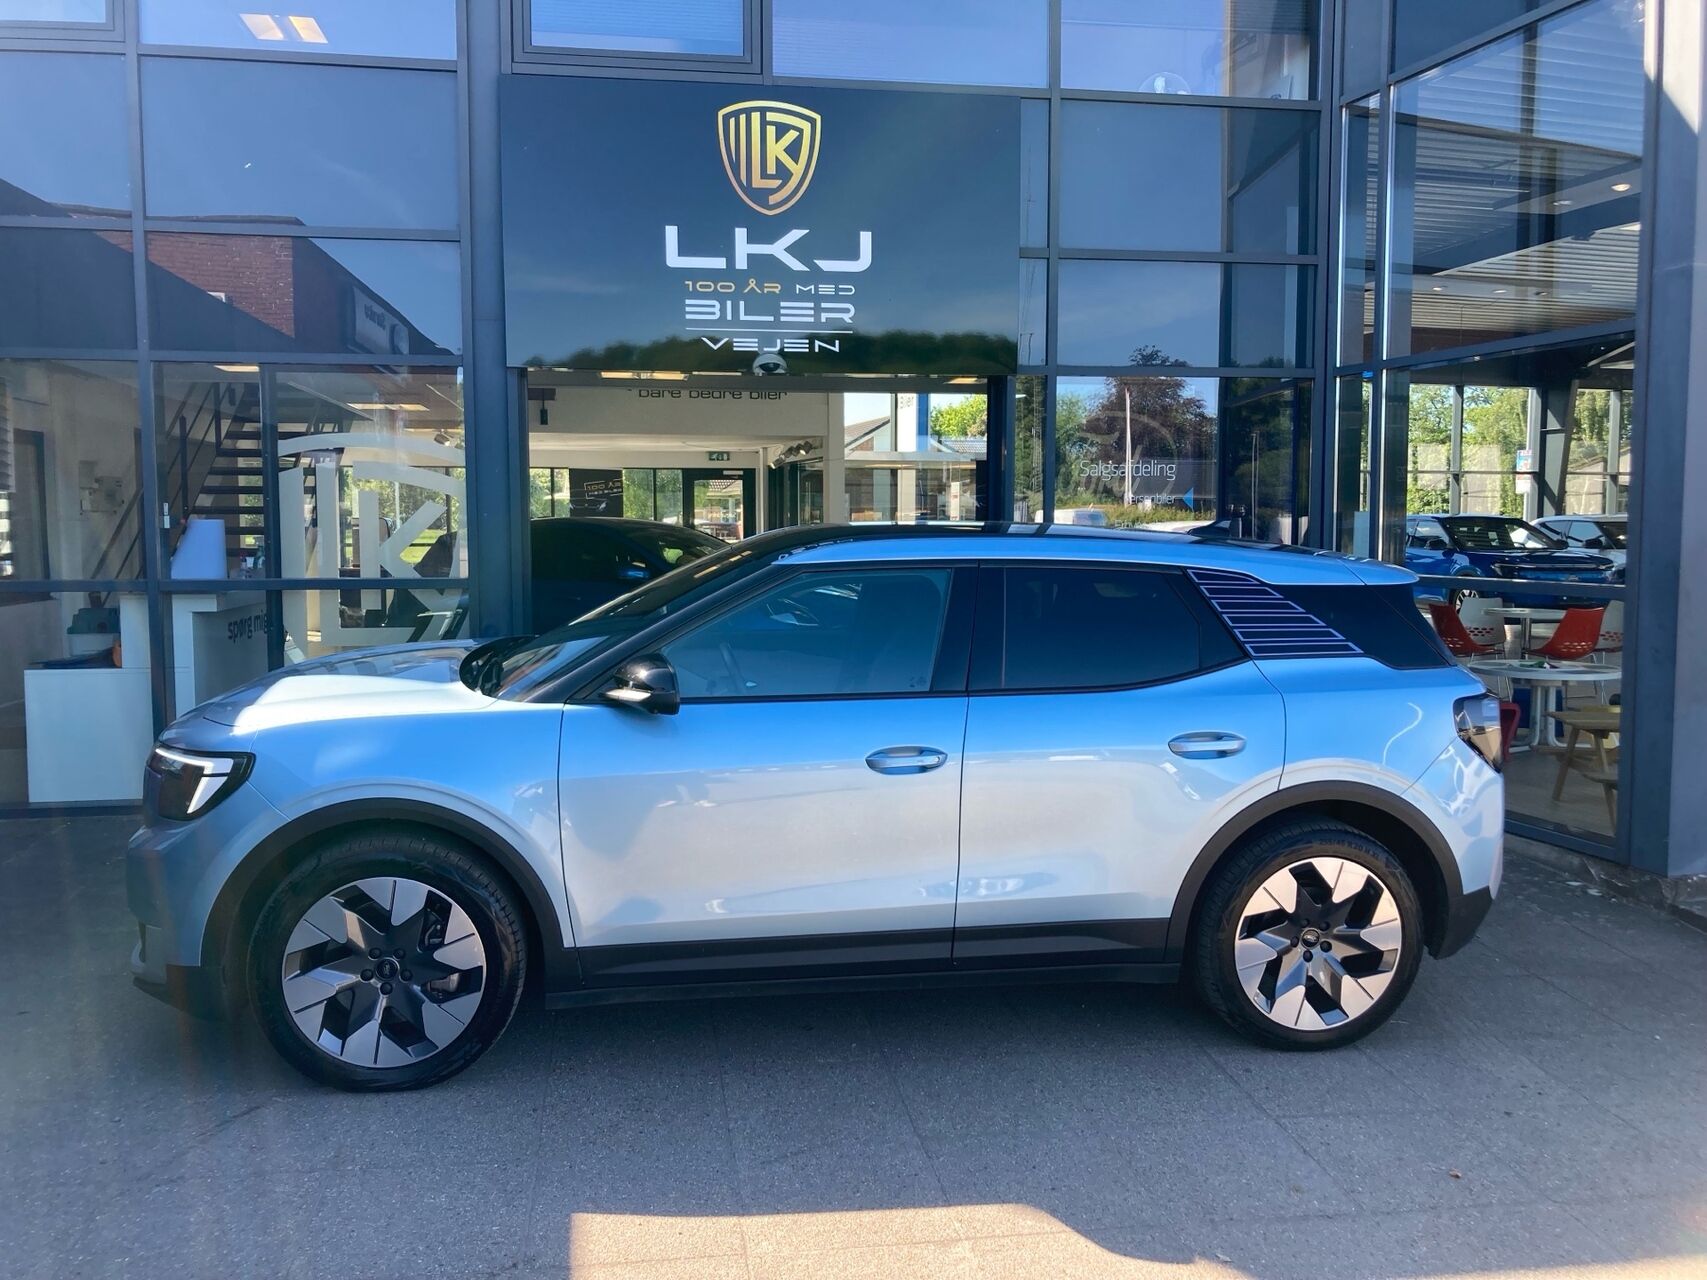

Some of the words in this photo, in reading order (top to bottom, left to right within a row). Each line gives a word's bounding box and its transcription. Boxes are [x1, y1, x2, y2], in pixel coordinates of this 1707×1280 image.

[665, 225, 872, 273] LKJ
[684, 280, 736, 293] 100
[743, 278, 782, 294] ÅR
[795, 283, 856, 295] MED
[684, 298, 856, 324] BILER
[701, 336, 840, 353] VEJEN
